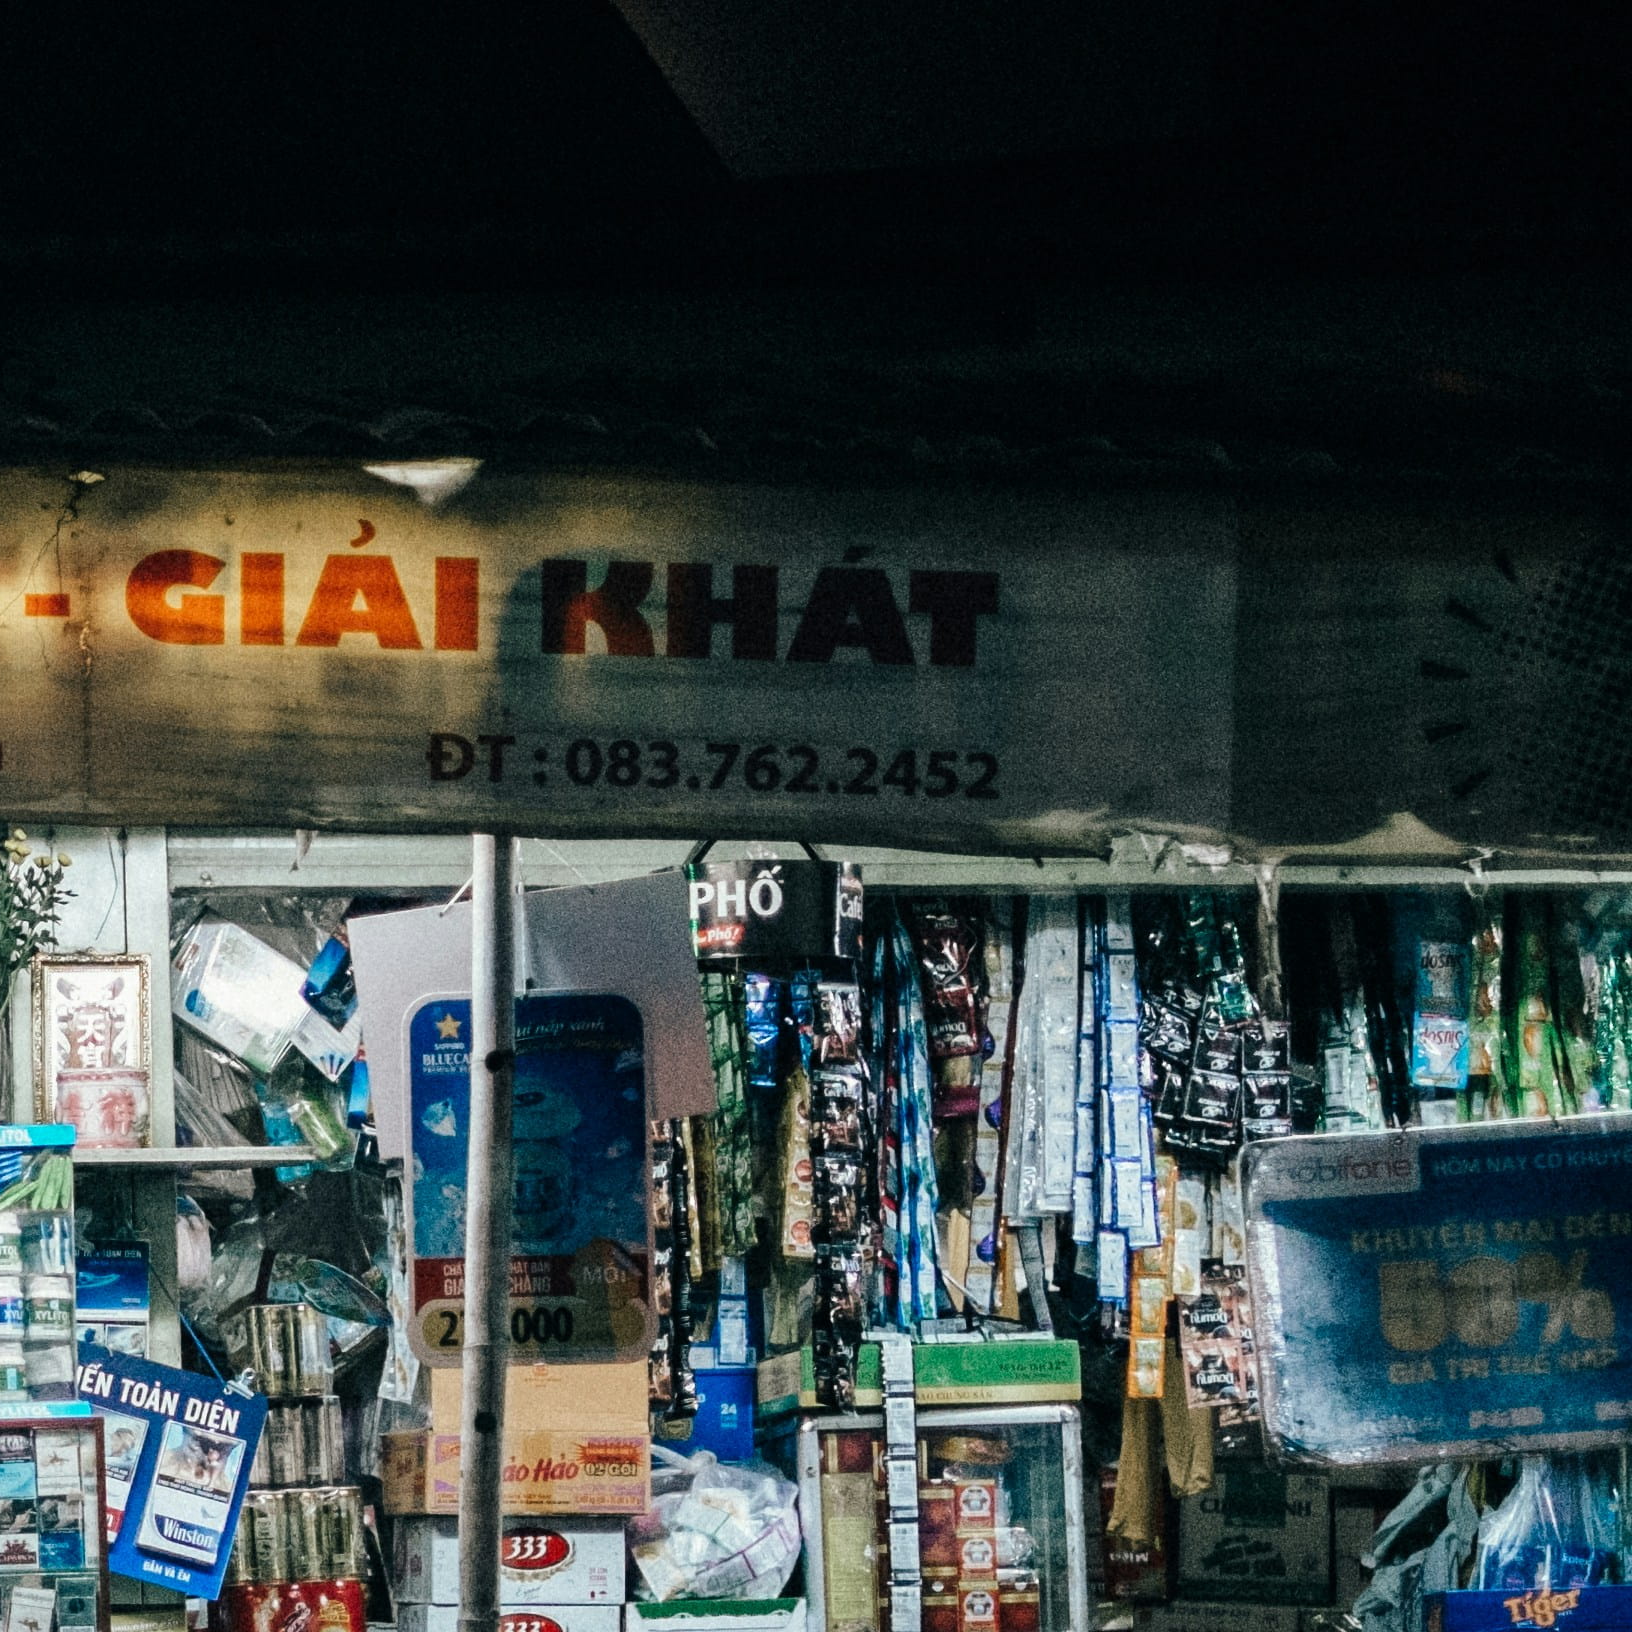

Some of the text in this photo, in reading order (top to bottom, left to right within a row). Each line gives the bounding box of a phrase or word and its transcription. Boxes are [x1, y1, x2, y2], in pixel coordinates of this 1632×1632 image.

[124, 518, 480, 652] GIẢI
[540, 545, 1002, 668] KHÁT
[563, 736, 1002, 802] 083.762.2452
[422, 1052, 473, 1066] BLUECA
[4, 1308, 24, 1320] XYLI
[503, 1455, 530, 1482] ảo
[505, 1535, 548, 1562] 333
[1502, 1588, 1582, 1628] Tiger
